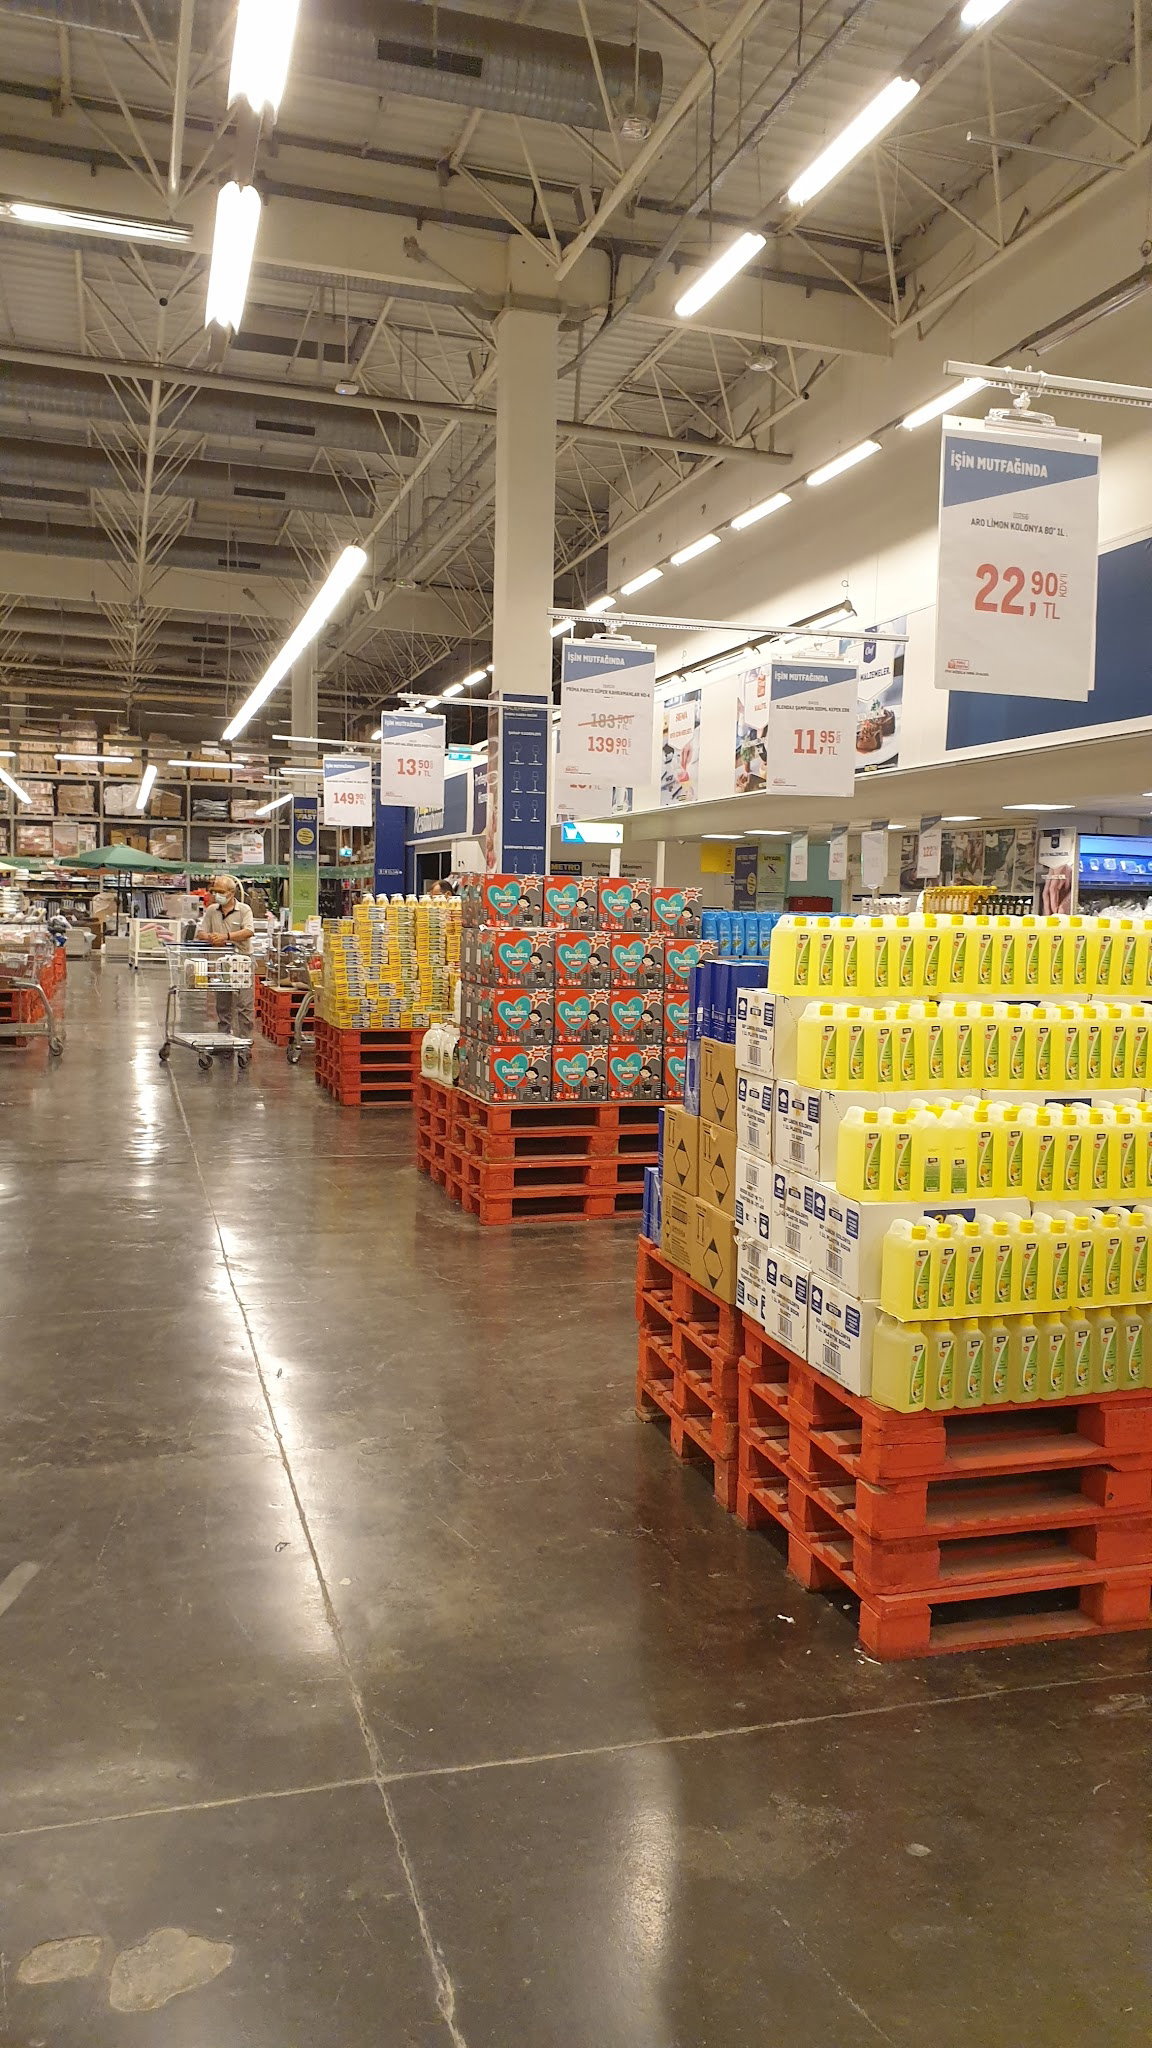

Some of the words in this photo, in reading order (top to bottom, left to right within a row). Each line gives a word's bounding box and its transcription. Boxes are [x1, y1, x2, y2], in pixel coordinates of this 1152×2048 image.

[976, 458, 1048, 478] MUTFAĞINDA
[1010, 521, 1043, 534] KOLONYA
[1043, 602, 1060, 620] TL
